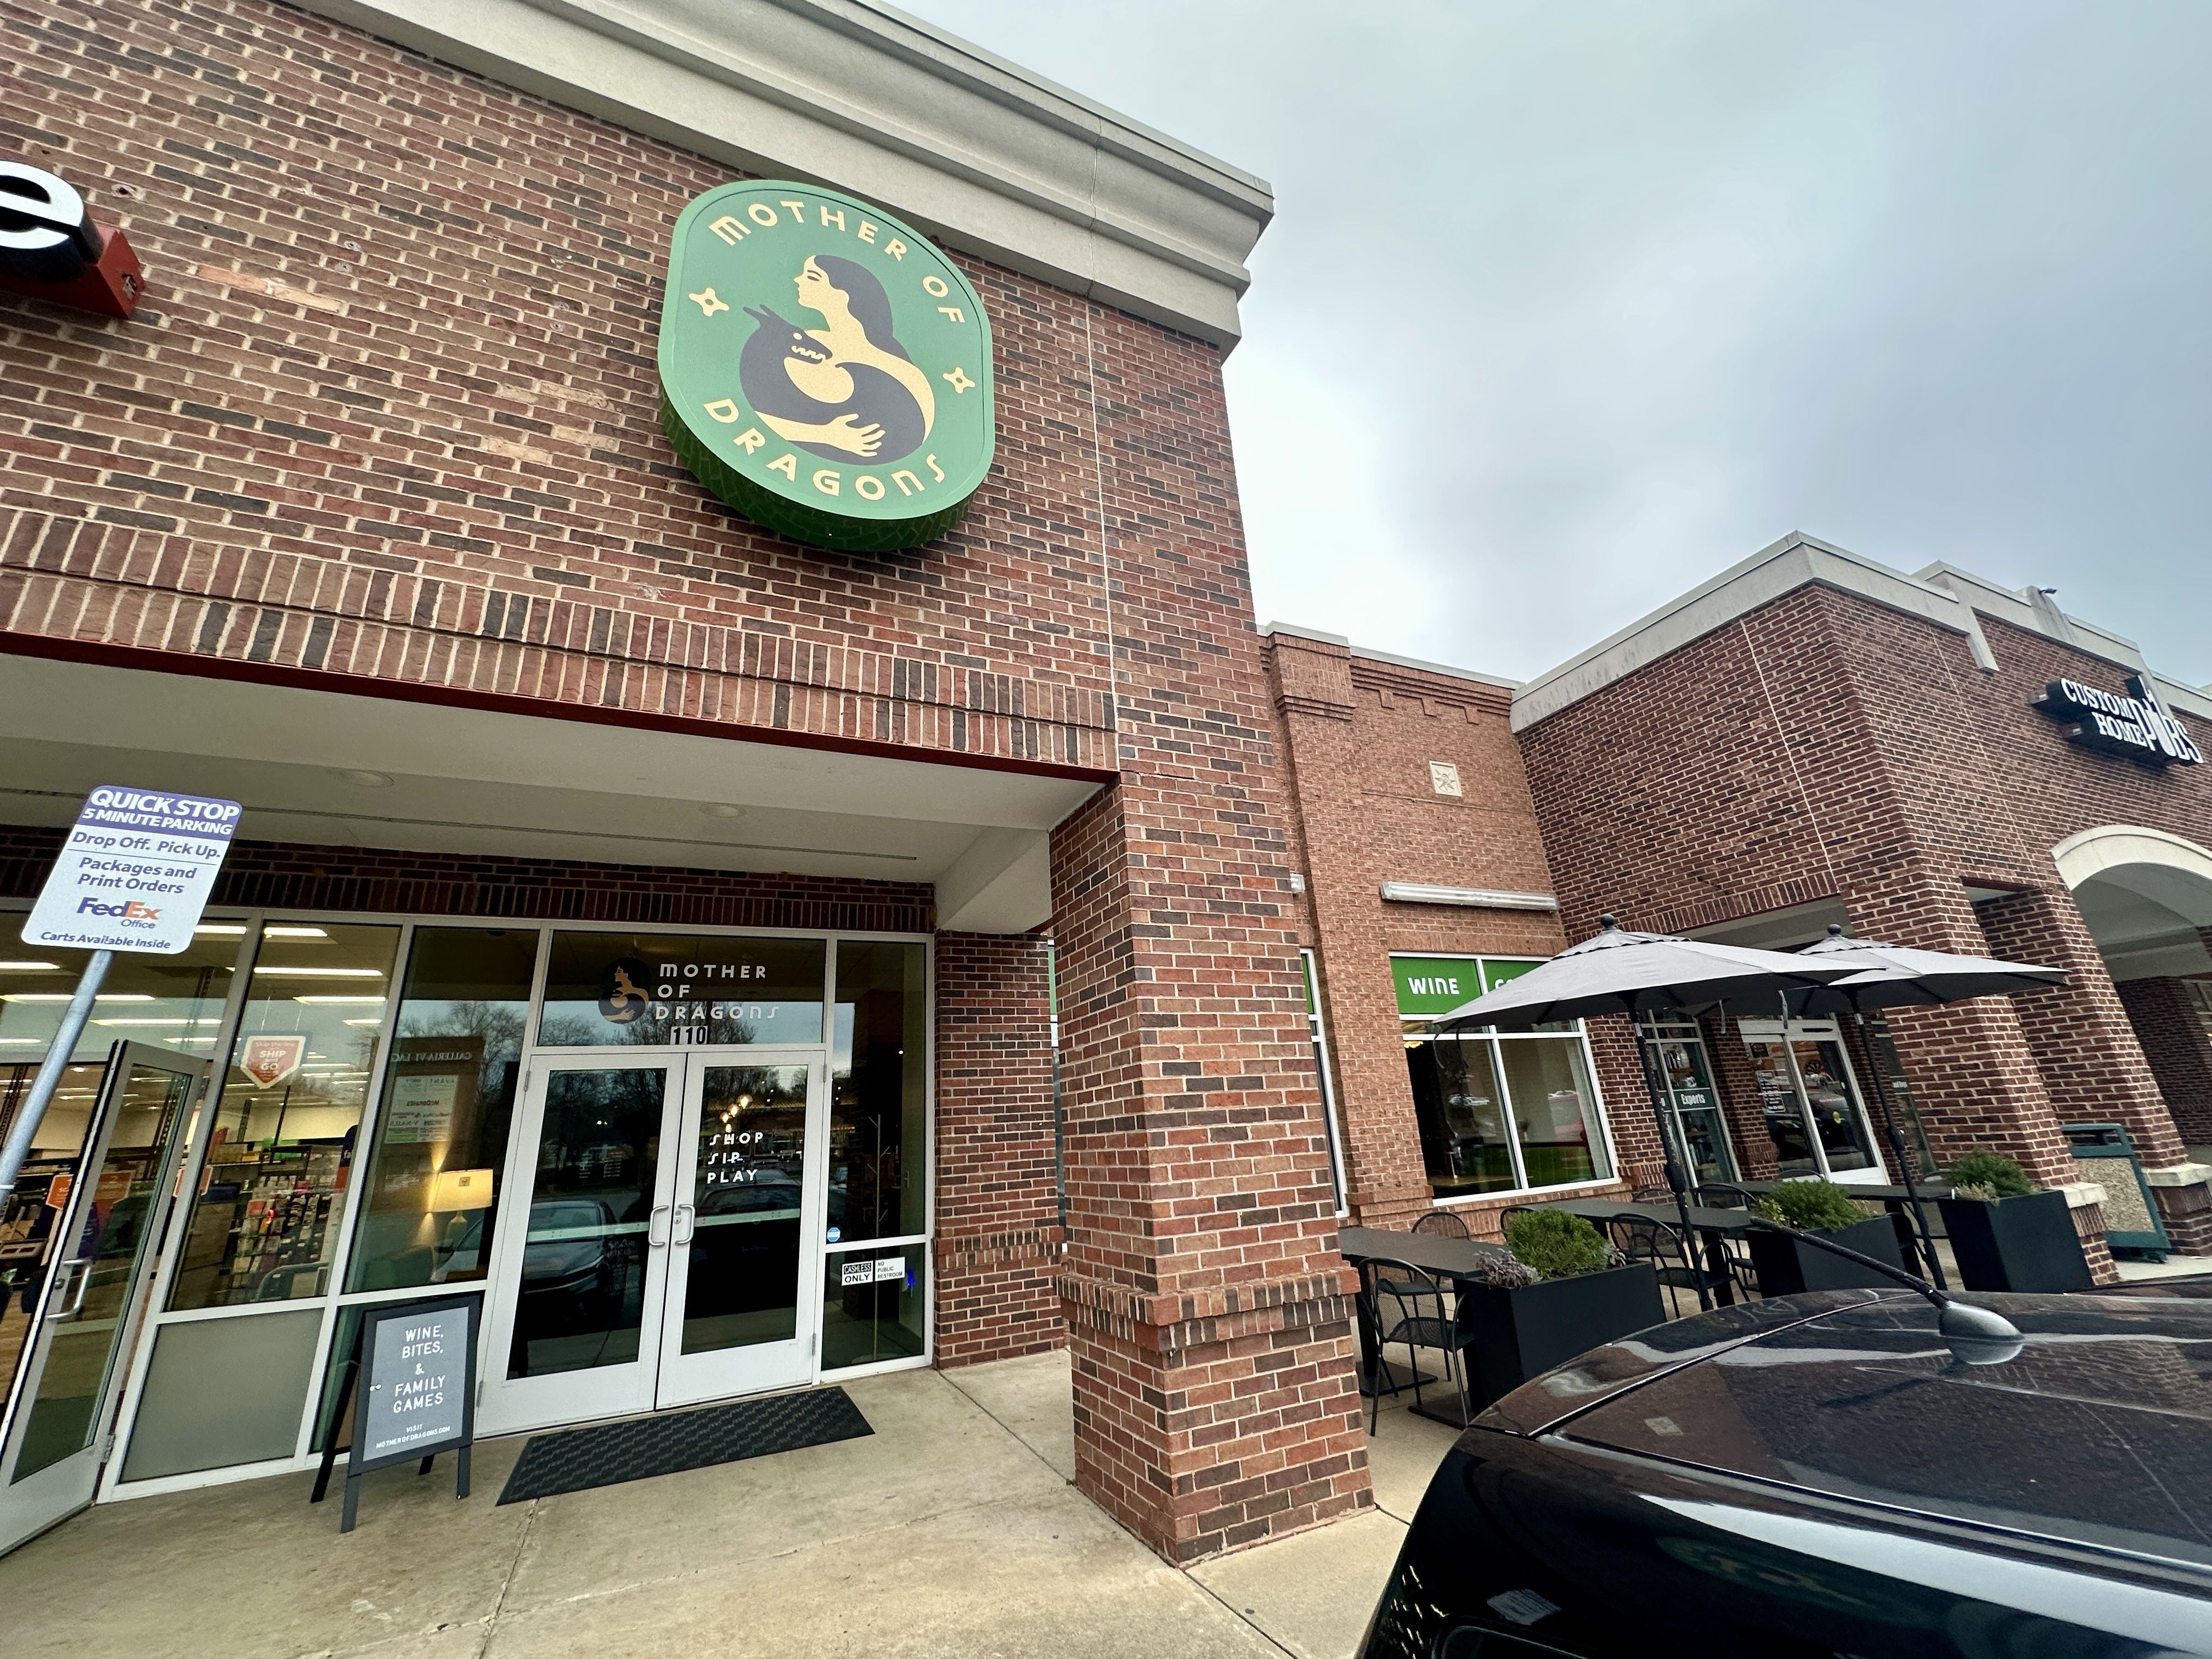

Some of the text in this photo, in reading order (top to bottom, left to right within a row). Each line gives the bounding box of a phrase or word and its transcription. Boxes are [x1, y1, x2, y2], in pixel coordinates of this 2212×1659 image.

[708, 200, 966, 324] MOTHER OF
[703, 398, 946, 501] DRAGONS
[2061, 678, 2136, 720] CUSTOM
[2091, 712, 2149, 747] HOME
[91, 789, 240, 821] QUICK STOP
[82, 808, 233, 835] 5 MINUTE PARKING
[72, 832, 221, 859] Drop Off. Pick Up.
[79, 857, 198, 878] Packages and
[77, 873, 185, 894] Print Orders
[76, 896, 163, 920] FedEx
[121, 918, 156, 929] Office
[41, 932, 171, 949] Carts Available Inside
[659, 963, 767, 979] MOTHER
[657, 984, 691, 998] OF
[1408, 977, 1459, 995] WINE
[655, 1005, 780, 1021] DRAGONS
[673, 1026, 707, 1045] 110
[1680, 1093, 1706, 1105] Experts
[709, 1132, 764, 1146] SHOP
[708, 1152, 741, 1165] SIP
[707, 1169, 758, 1184] PLAY
[844, 1263, 871, 1273] CASHLESS
[845, 1273, 870, 1283] ONLY
[415, 1363, 424, 1375] &
[394, 1375, 445, 1397] FAMILY
[393, 1392, 443, 1413] GAMES
[406, 1424, 423, 1432] VISIT
